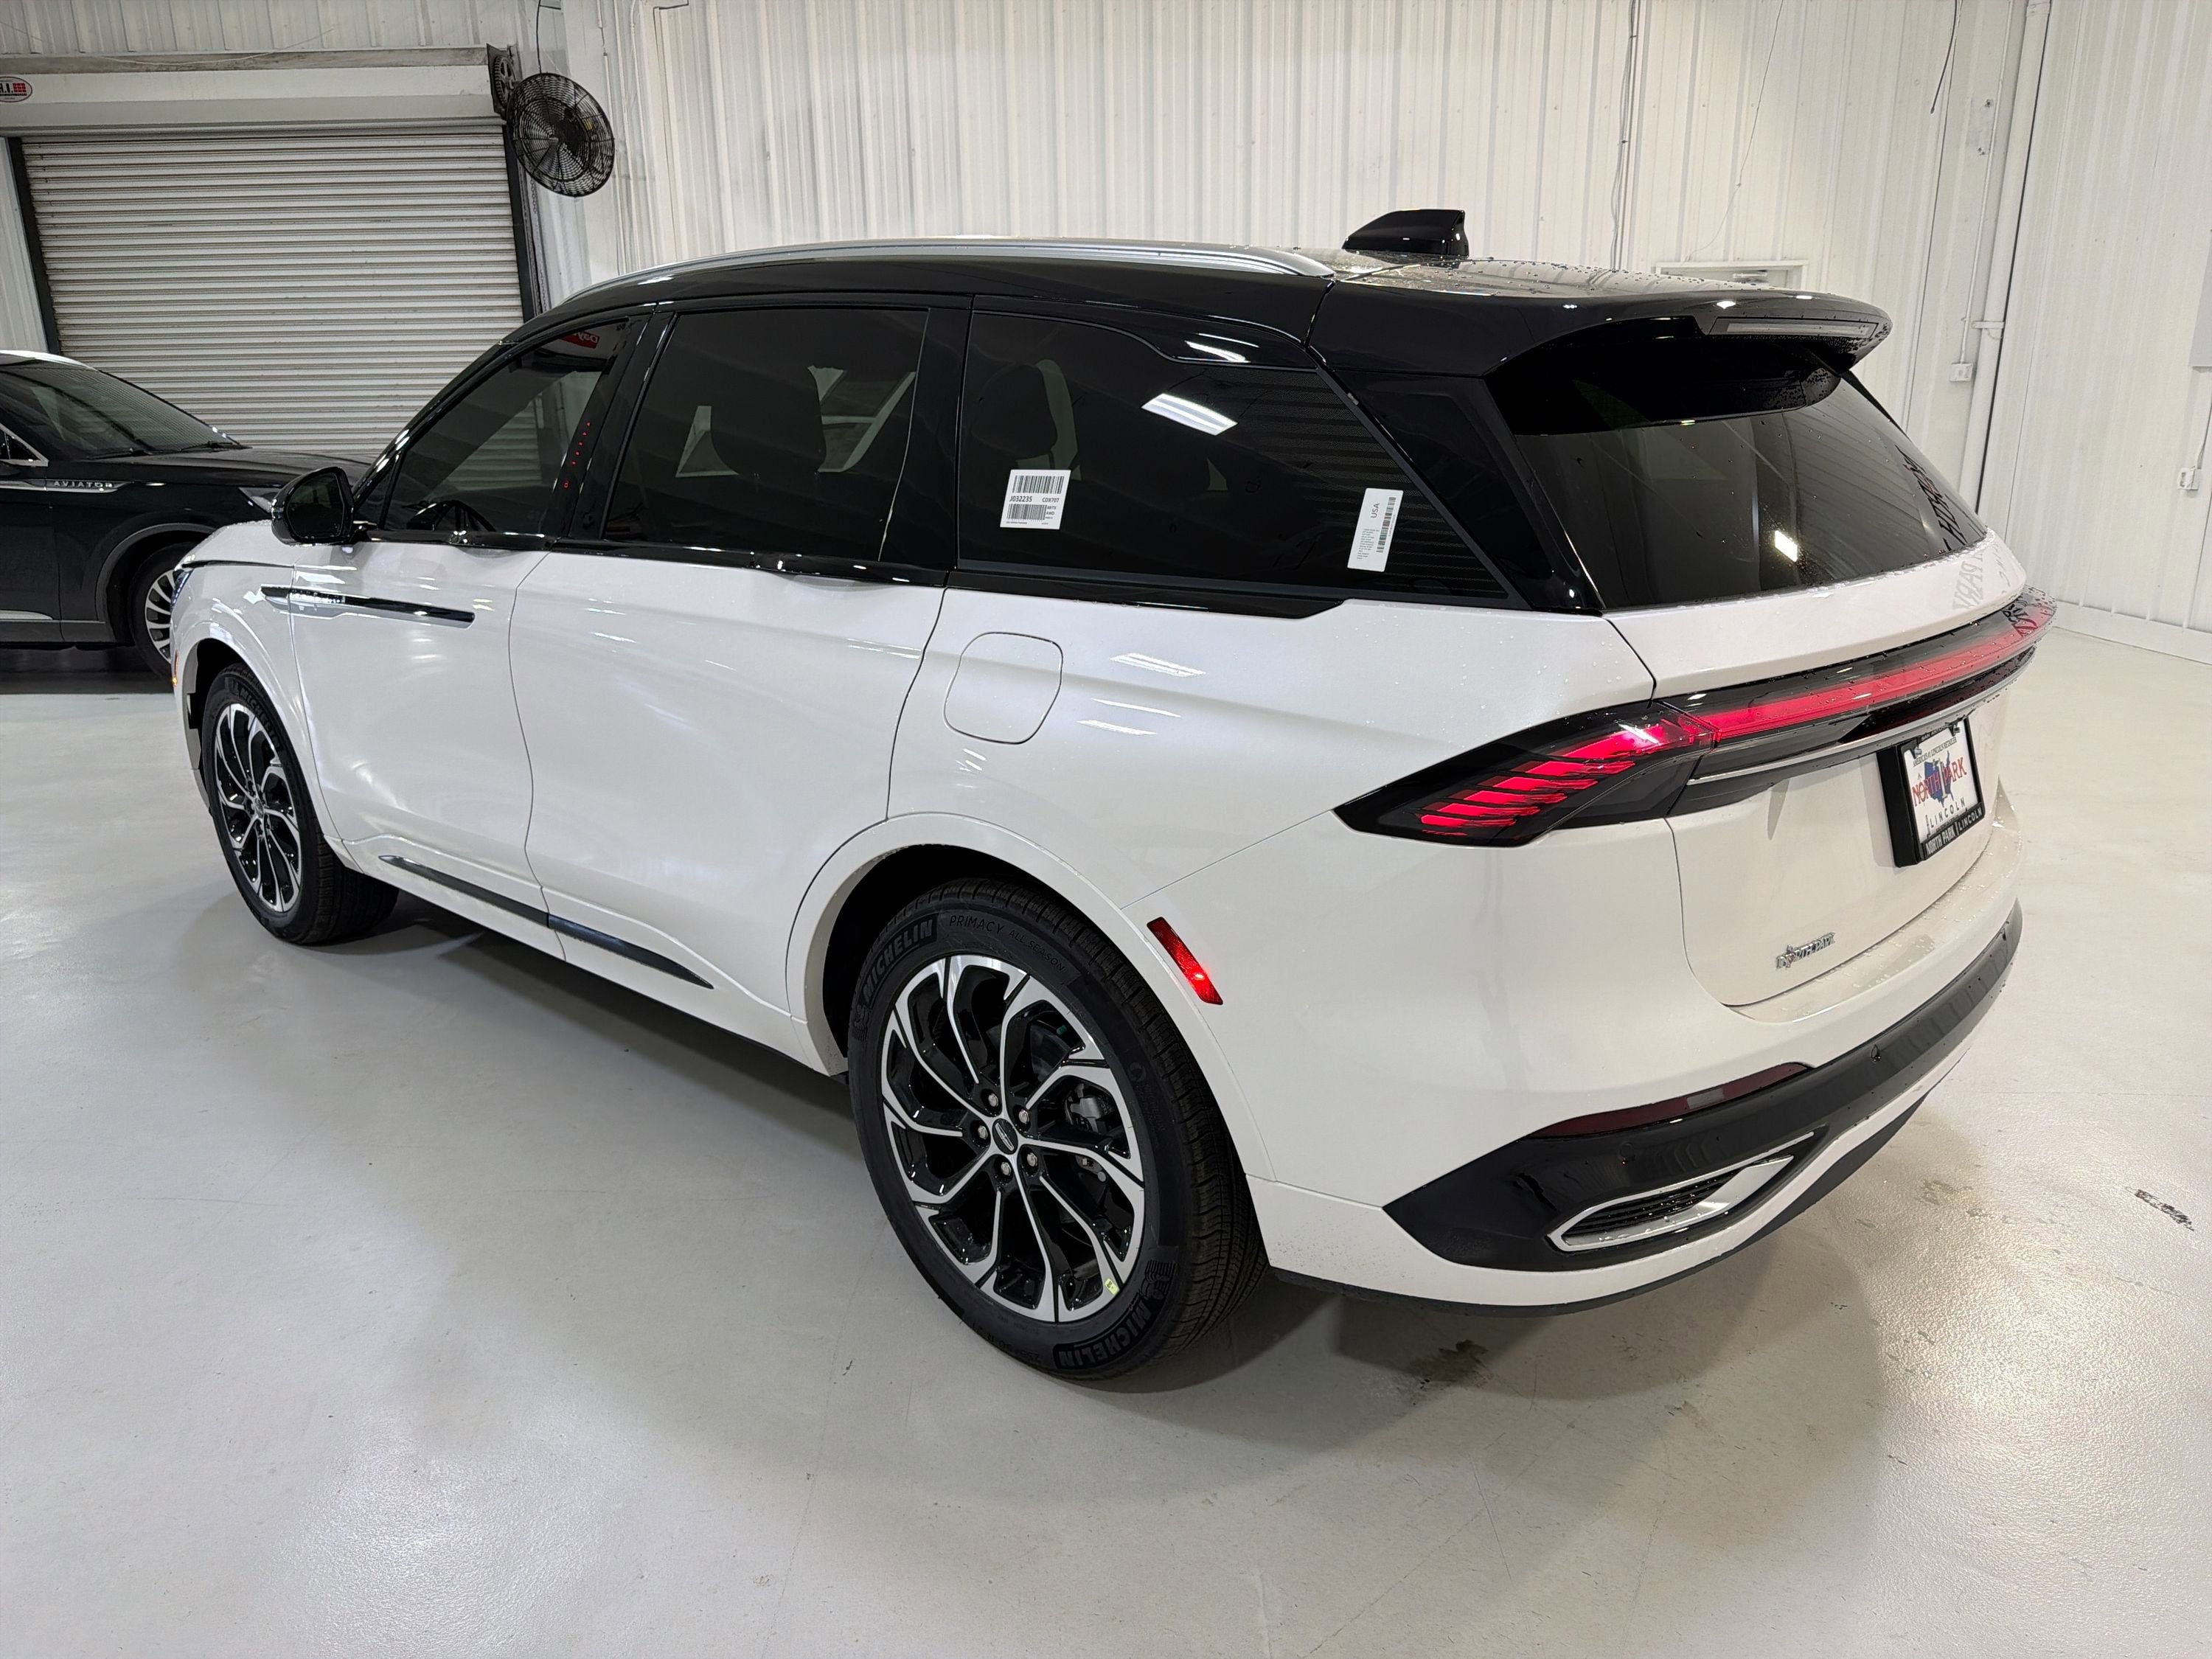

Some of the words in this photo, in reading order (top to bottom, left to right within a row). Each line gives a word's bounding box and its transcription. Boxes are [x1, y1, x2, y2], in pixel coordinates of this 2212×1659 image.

[53, 480, 113, 488] AVIATOR
[1009, 495, 1033, 503] J032235
[1370, 503, 1380, 518] USA
[1912, 772, 1941, 807] NORTH
[1942, 757, 1967, 786] PARK
[1925, 834, 1943, 856] NORTH
[1942, 824, 1956, 844] PARK
[1958, 807, 1983, 832] LINCOLN
[1930, 797, 1966, 829] LINCOLN
[862, 918, 934, 1004] MICHELIN
[949, 914, 1006, 934] PRIMACY
[1009, 929, 1026, 945] ALL
[1026, 939, 1067, 973] SEASON
[1057, 1300, 1152, 1367] MICHELIN
